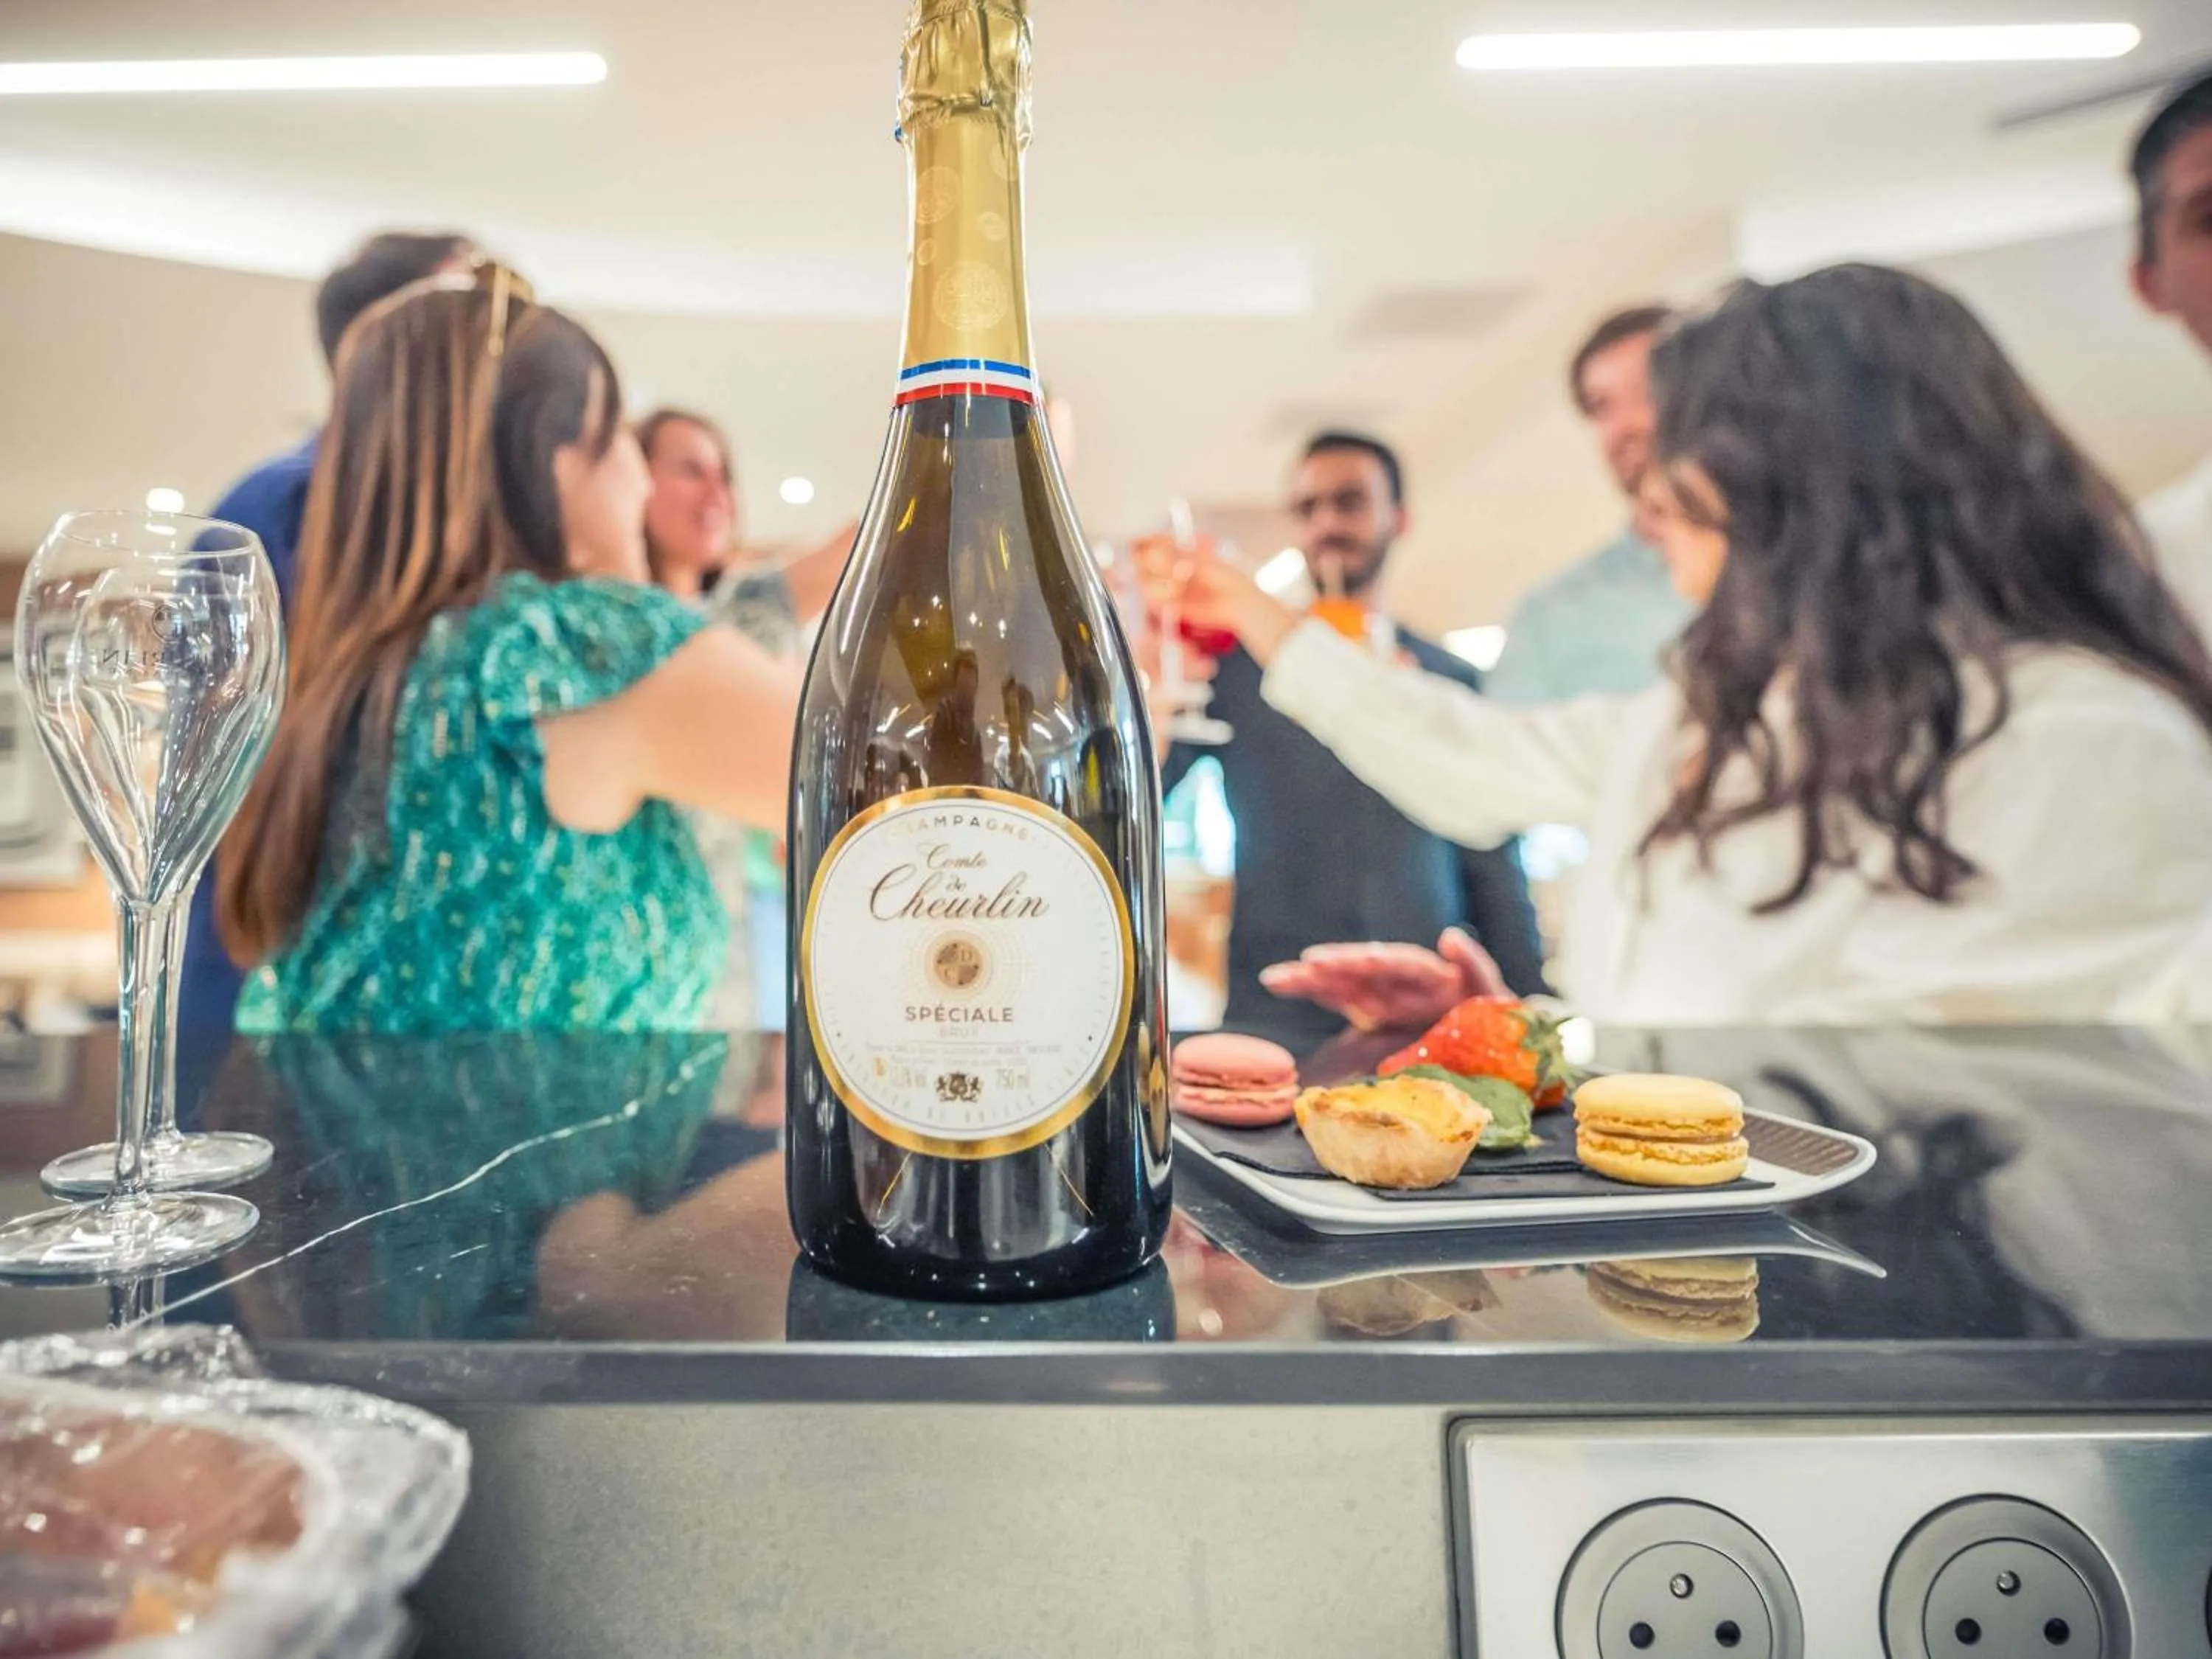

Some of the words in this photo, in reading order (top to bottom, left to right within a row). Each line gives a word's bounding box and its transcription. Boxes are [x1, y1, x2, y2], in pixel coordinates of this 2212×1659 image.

[890, 815, 1029, 841] AMPAGNE
[917, 843, 987, 869] Comte
[869, 863, 1048, 921] Cheurlin
[905, 1004, 1013, 1023] SPÉCIALE
